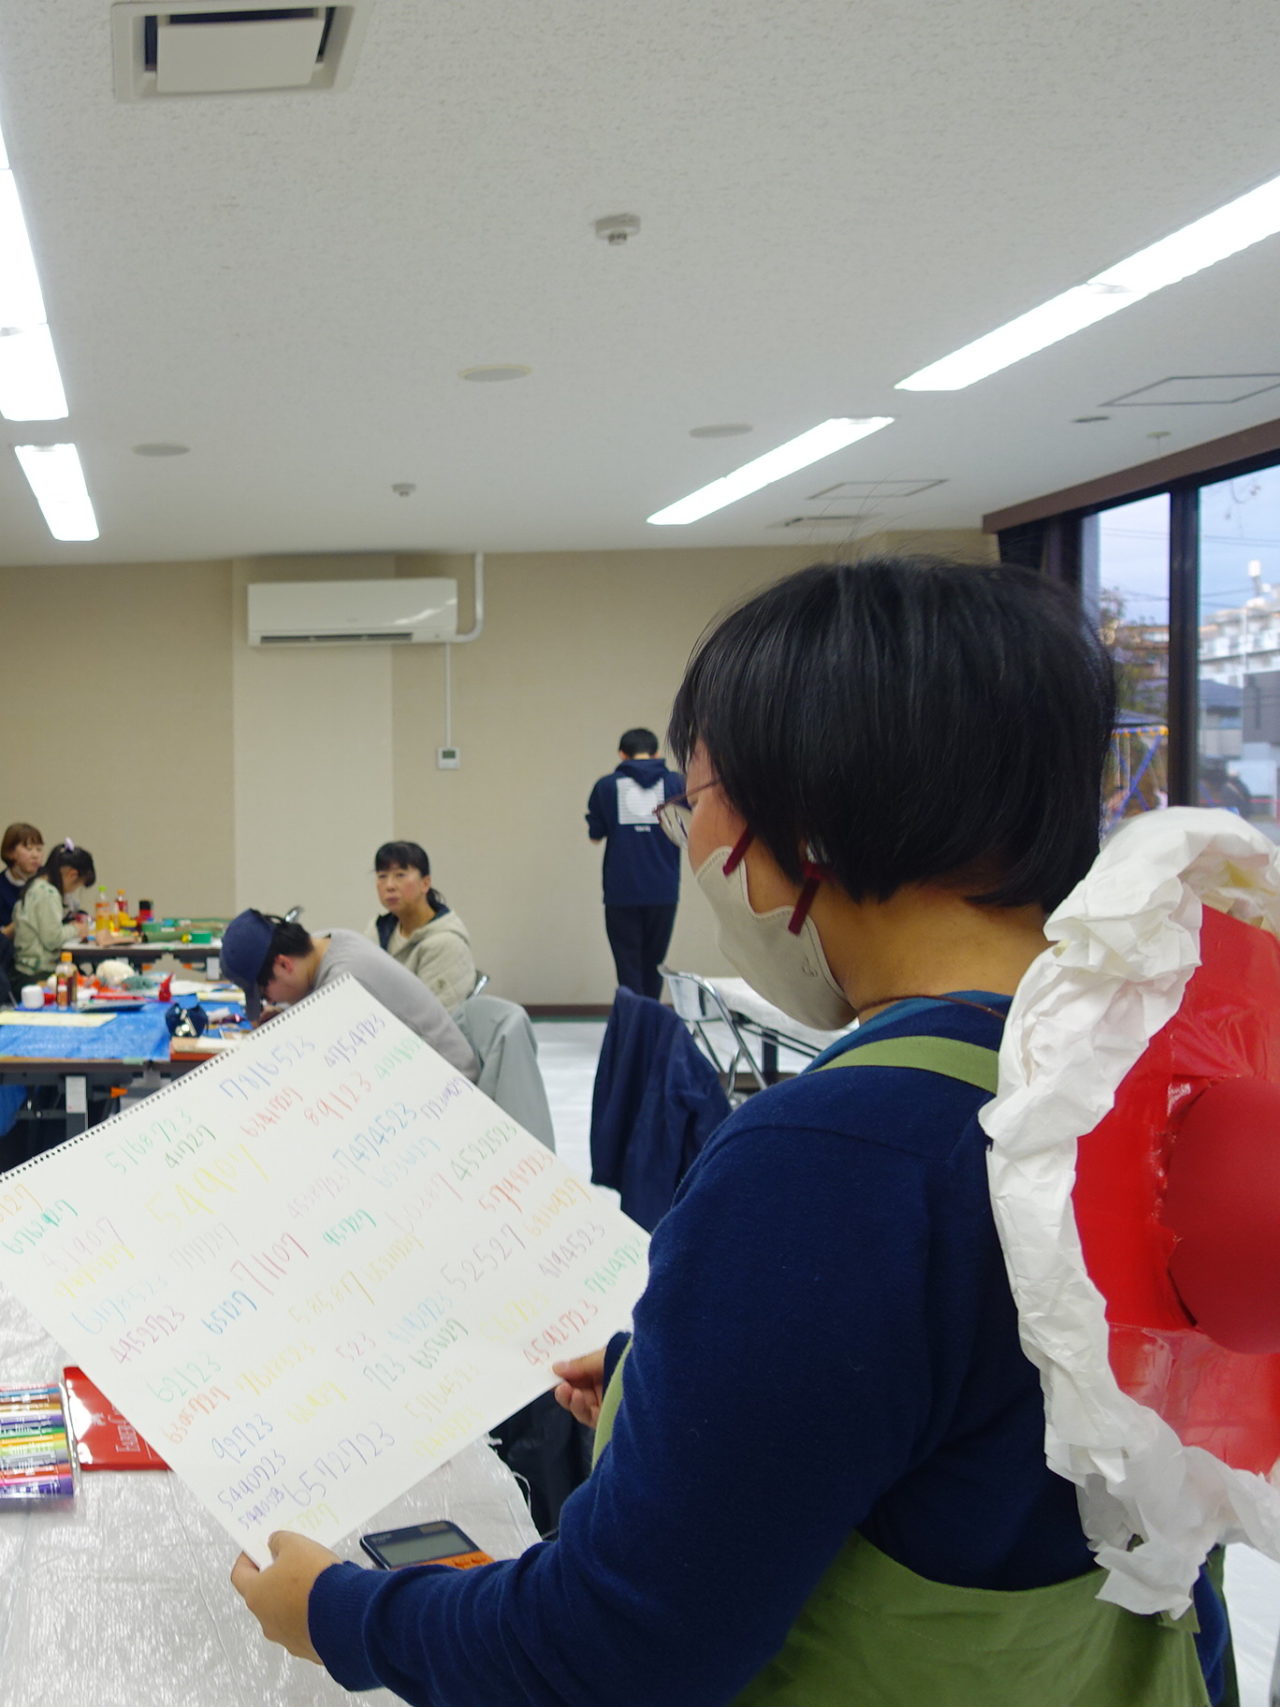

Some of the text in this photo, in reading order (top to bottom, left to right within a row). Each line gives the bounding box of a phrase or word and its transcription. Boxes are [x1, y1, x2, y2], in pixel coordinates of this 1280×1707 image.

[303, 1072, 372, 1127] 89123
[331, 1101, 419, 1175] 7474523
[229, 1231, 312, 1298] 71107
[439, 1221, 528, 1292] 52527
[201, 1289, 258, 1336] 65127
[147, 1352, 223, 1405] 62123
[361, 1352, 408, 1392] 723
[210, 1411, 275, 1466] 92723
[282, 1421, 397, 1509] 6572723
